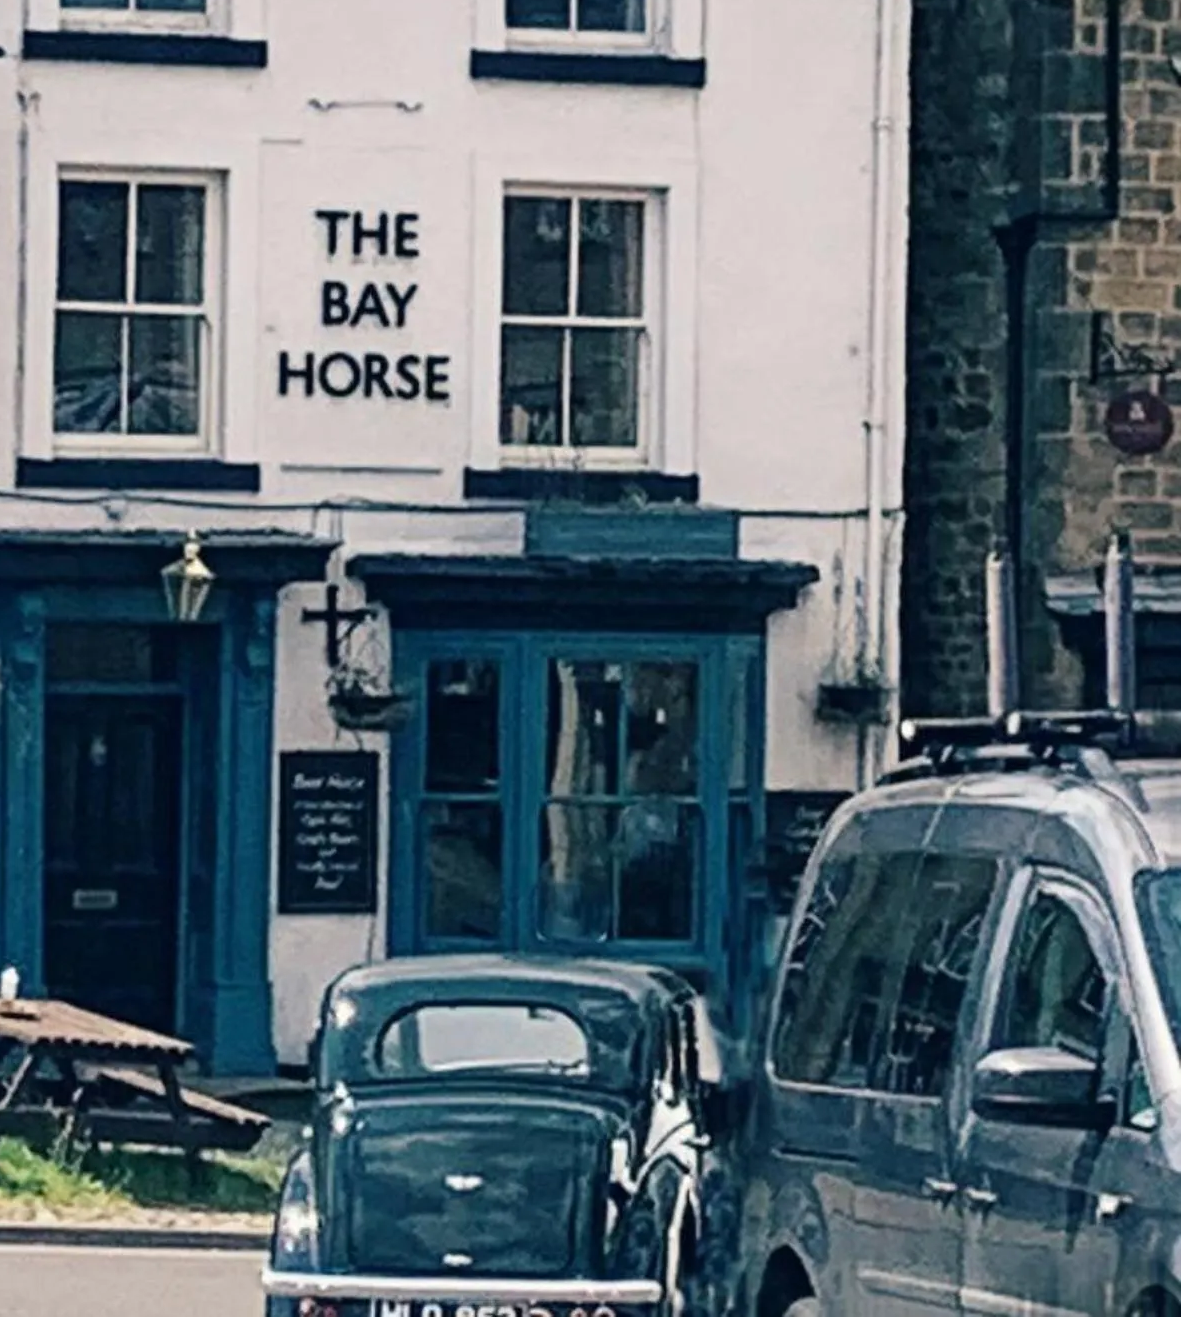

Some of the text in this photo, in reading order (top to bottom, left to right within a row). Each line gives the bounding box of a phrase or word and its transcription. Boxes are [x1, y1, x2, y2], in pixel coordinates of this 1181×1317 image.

[315, 210, 420, 258] THE
[321, 280, 419, 328] BAY
[278, 351, 451, 401] HORSE
